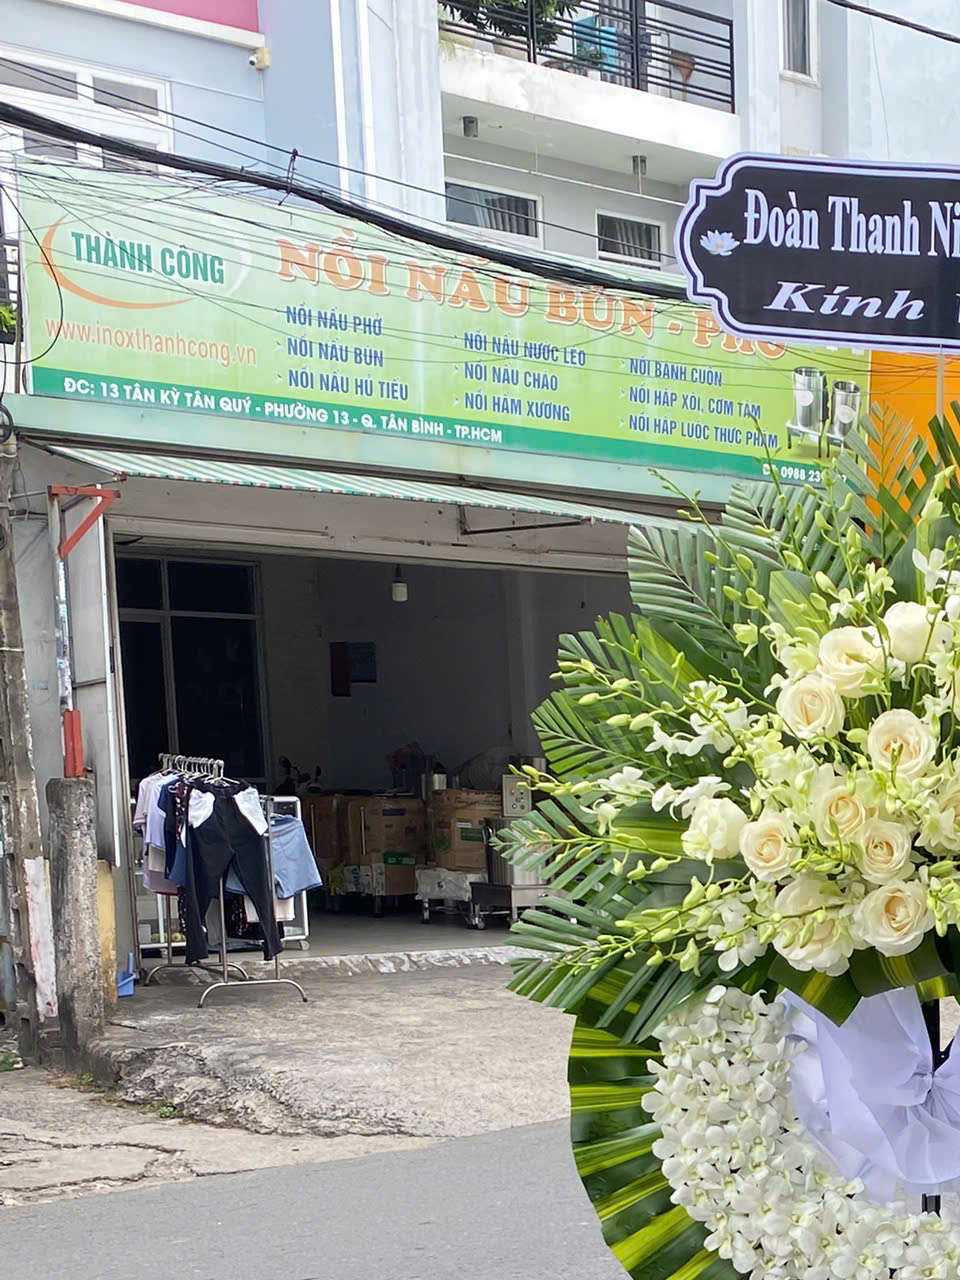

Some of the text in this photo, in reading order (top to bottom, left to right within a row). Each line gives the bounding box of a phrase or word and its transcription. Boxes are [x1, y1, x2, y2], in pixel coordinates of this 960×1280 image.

[743, 189, 820, 250] Đoàn
[828, 196, 920, 256] Thanh
[71, 231, 225, 284] THÀNH CÔNG
[275, 226, 389, 296] NỒI
[353, 312, 383, 336] PHỞ
[762, 280, 925, 321] Kính
[45, 319, 257, 369] www.inoxthanhcong.vn
[63, 377, 95, 395] ĐC:
[101, 382, 119, 398] 13
[123, 383, 158, 402] TÂN
[160, 385, 182, 404] KỲ
[184, 389, 215, 411] TÂN
[220, 395, 251, 413] QUÝ
[265, 401, 328, 423] PHƯỜNG
[332, 409, 350, 425] 13
[361, 413, 377, 430] Q.
[381, 413, 408, 433] TÂN
[412, 416, 444, 438] BÌNH
[454, 425, 502, 442] TP.HCM
[378, 377, 408, 401] TIẾU
[780, 466, 806, 481] 0988
